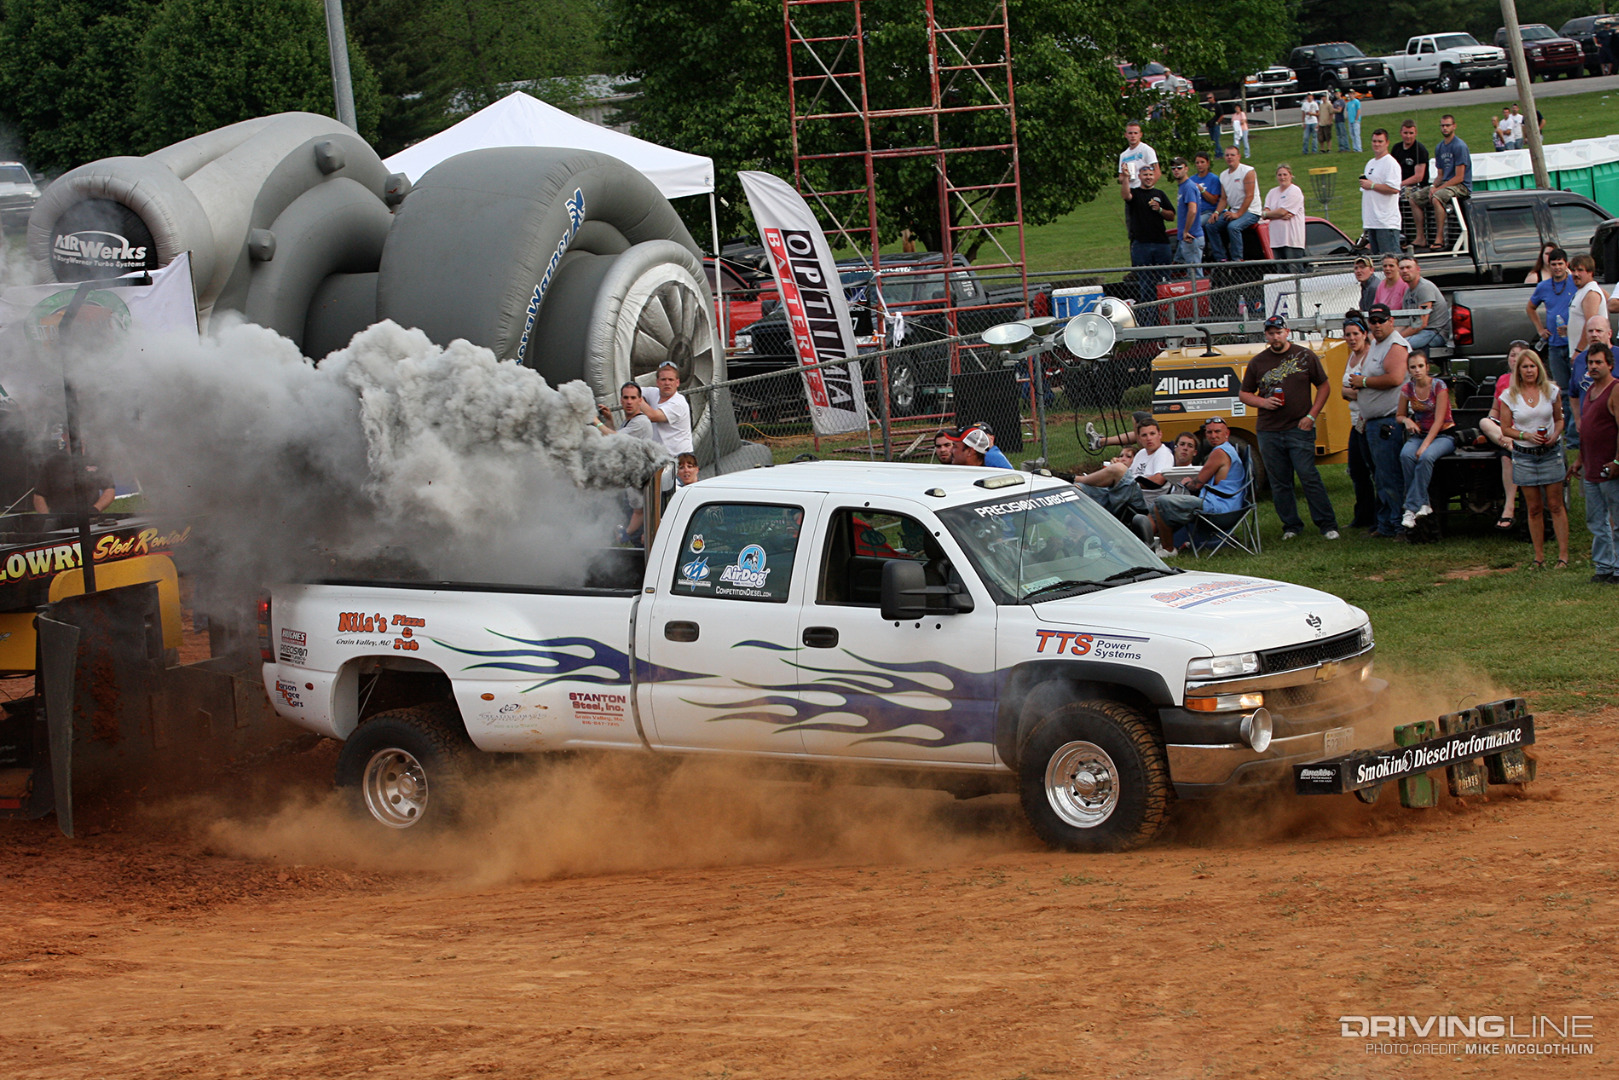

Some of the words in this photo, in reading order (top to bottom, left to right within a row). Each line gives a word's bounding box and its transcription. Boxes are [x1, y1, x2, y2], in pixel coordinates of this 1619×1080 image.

[54, 231, 147, 260] AIRWerks
[94, 260, 115, 268] Turbo
[115, 260, 146, 269] Systems
[516, 229, 571, 366] orgWarner
[766, 231, 827, 407] BATTERIES
[786, 233, 848, 405] OPTIMA
[1154, 374, 1229, 395] Allmand
[974, 499, 1038, 518] PRECISION
[1036, 494, 1067, 507] TURBO
[93, 535, 135, 561] Sled
[135, 526, 192, 554] Rental
[720, 566, 771, 588] AirDog
[338, 612, 388, 633] Nila's
[391, 614, 425, 628] Pizza
[401, 627, 413, 638] &
[393, 638, 419, 651] Pub
[1036, 631, 1094, 656] TTS
[1096, 640, 1132, 650] Power
[1094, 648, 1141, 660] Systems
[569, 692, 626, 704] STANTON
[572, 701, 604, 711] Steel,
[605, 703, 625, 712] Inc.
[1356, 757, 1402, 785] Smokin
[1414, 745, 1450, 769] Diesel
[1451, 726, 1522, 760] Performance
